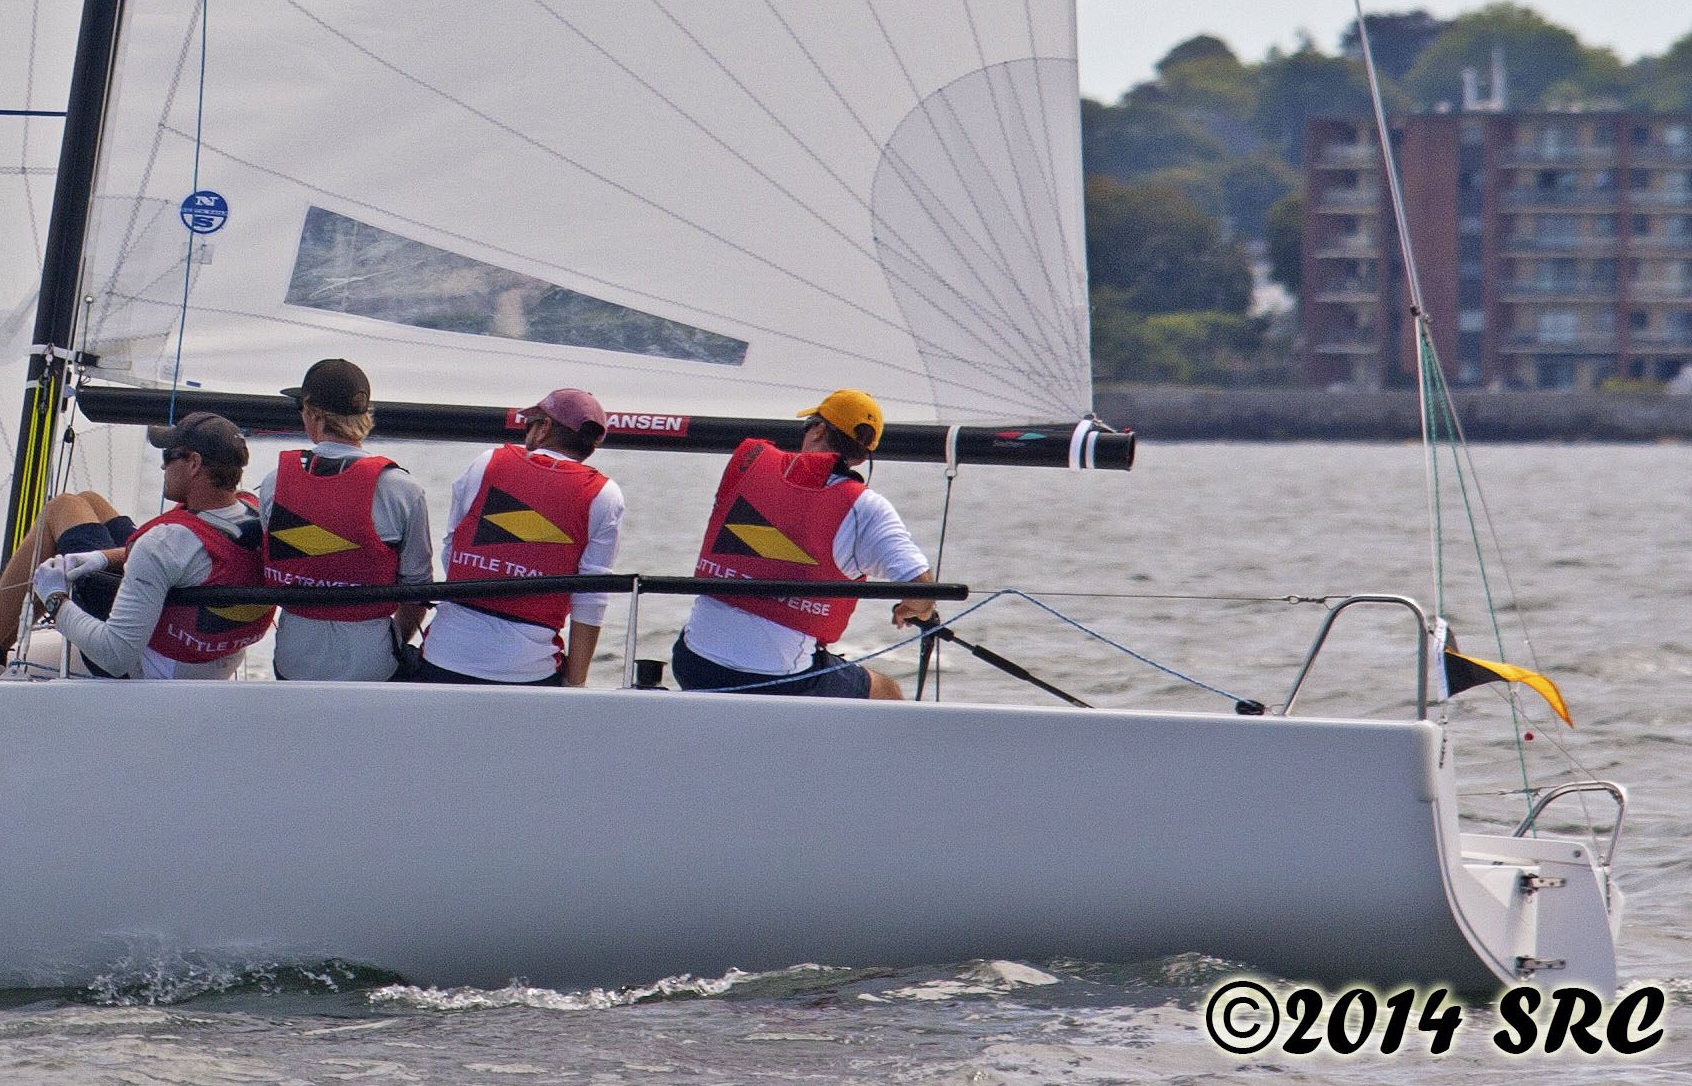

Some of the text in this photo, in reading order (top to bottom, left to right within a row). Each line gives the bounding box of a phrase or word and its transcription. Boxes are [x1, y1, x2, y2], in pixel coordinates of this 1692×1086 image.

[607, 414, 683, 432] ANSEN
[452, 550, 501, 573] LITTLE
[168, 622, 229, 652] LITTLE
